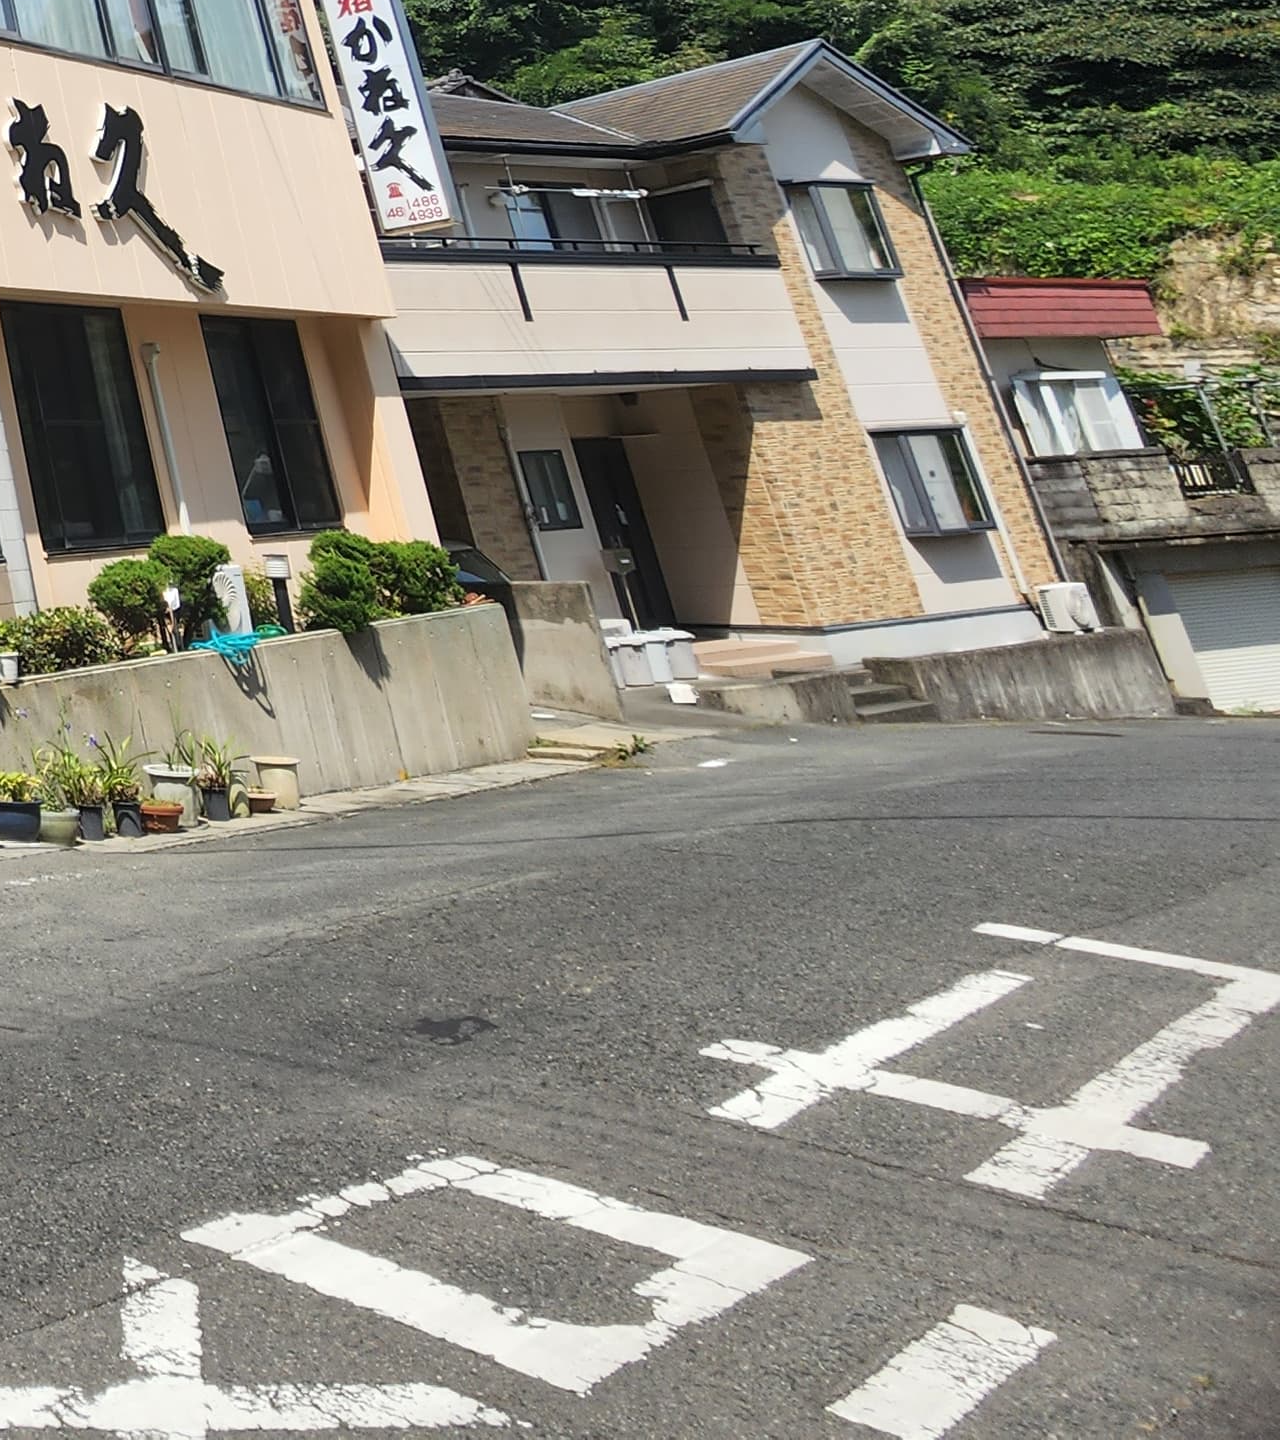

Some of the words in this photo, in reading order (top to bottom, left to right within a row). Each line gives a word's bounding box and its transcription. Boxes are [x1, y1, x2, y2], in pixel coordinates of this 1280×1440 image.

[341, 16, 435, 192] かね久
[405, 194, 439, 210] 1486
